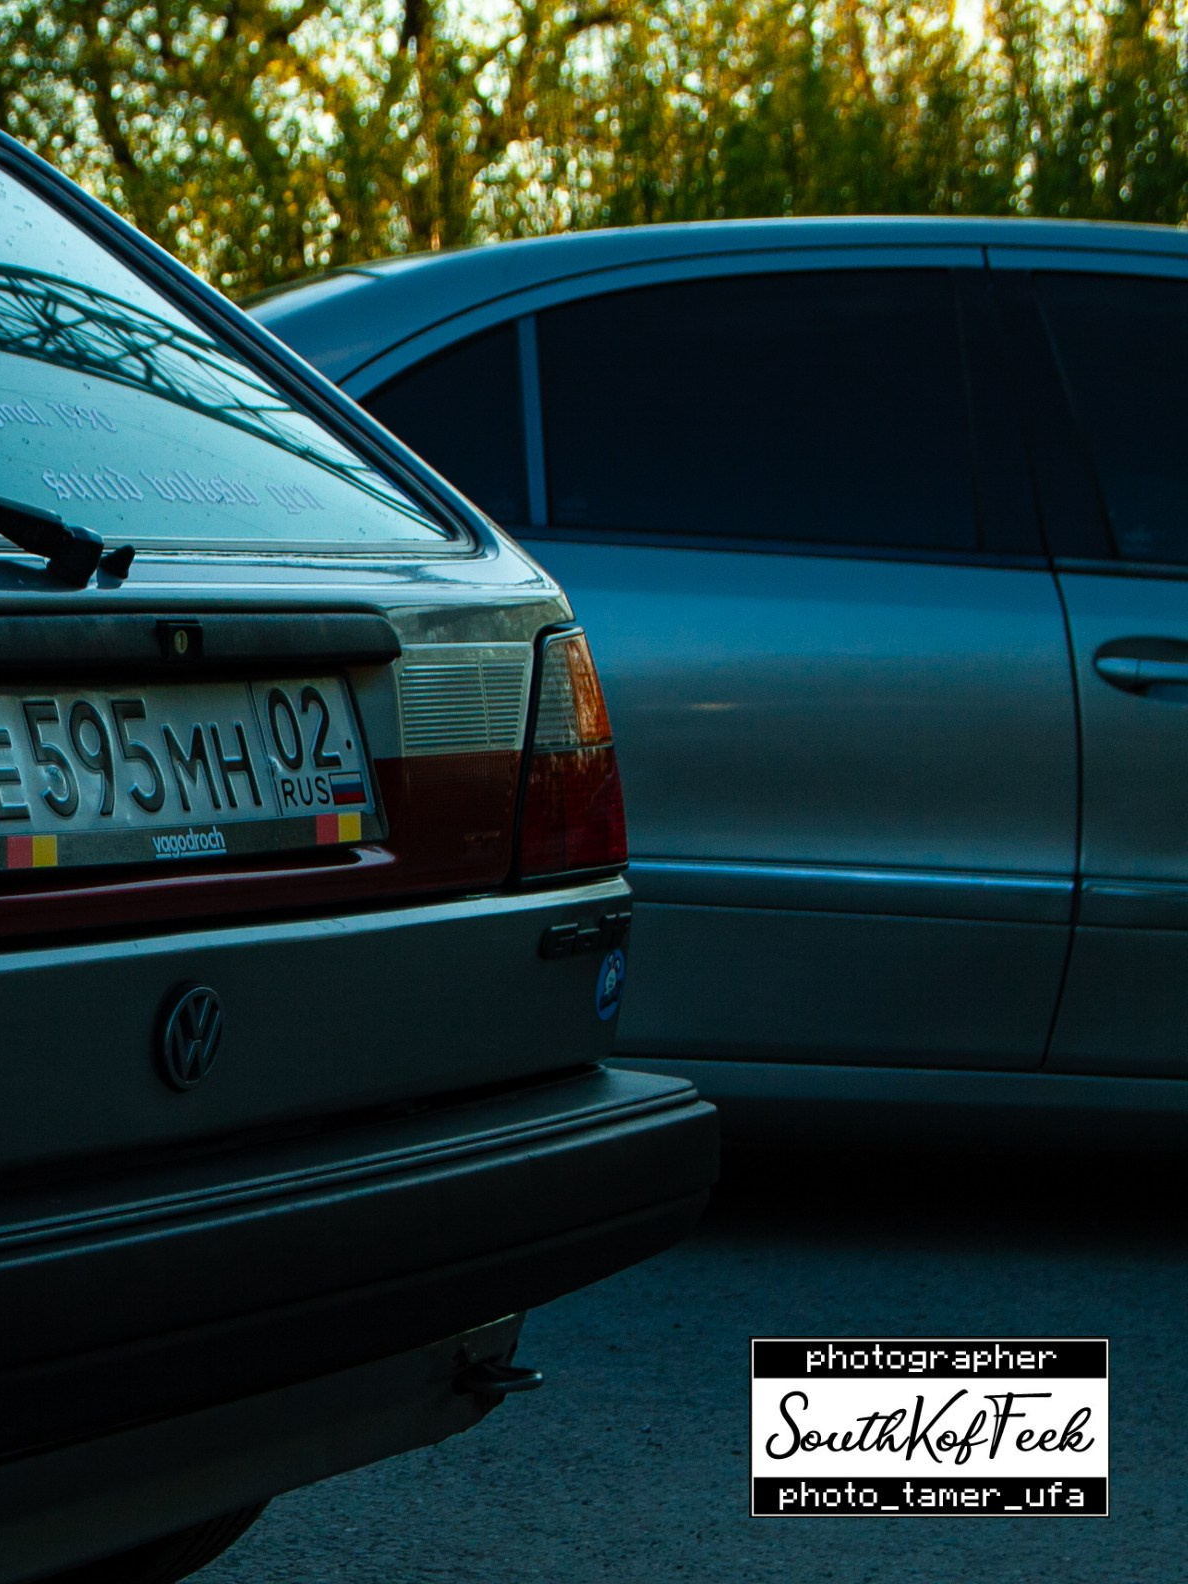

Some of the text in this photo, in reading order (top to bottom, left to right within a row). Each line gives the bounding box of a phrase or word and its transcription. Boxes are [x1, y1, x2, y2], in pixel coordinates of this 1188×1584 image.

[47, 401, 118, 433] 1990
[267, 685, 341, 771] 02
[280, 778, 331, 807] RUS
[152, 825, 226, 858] vagodroch
